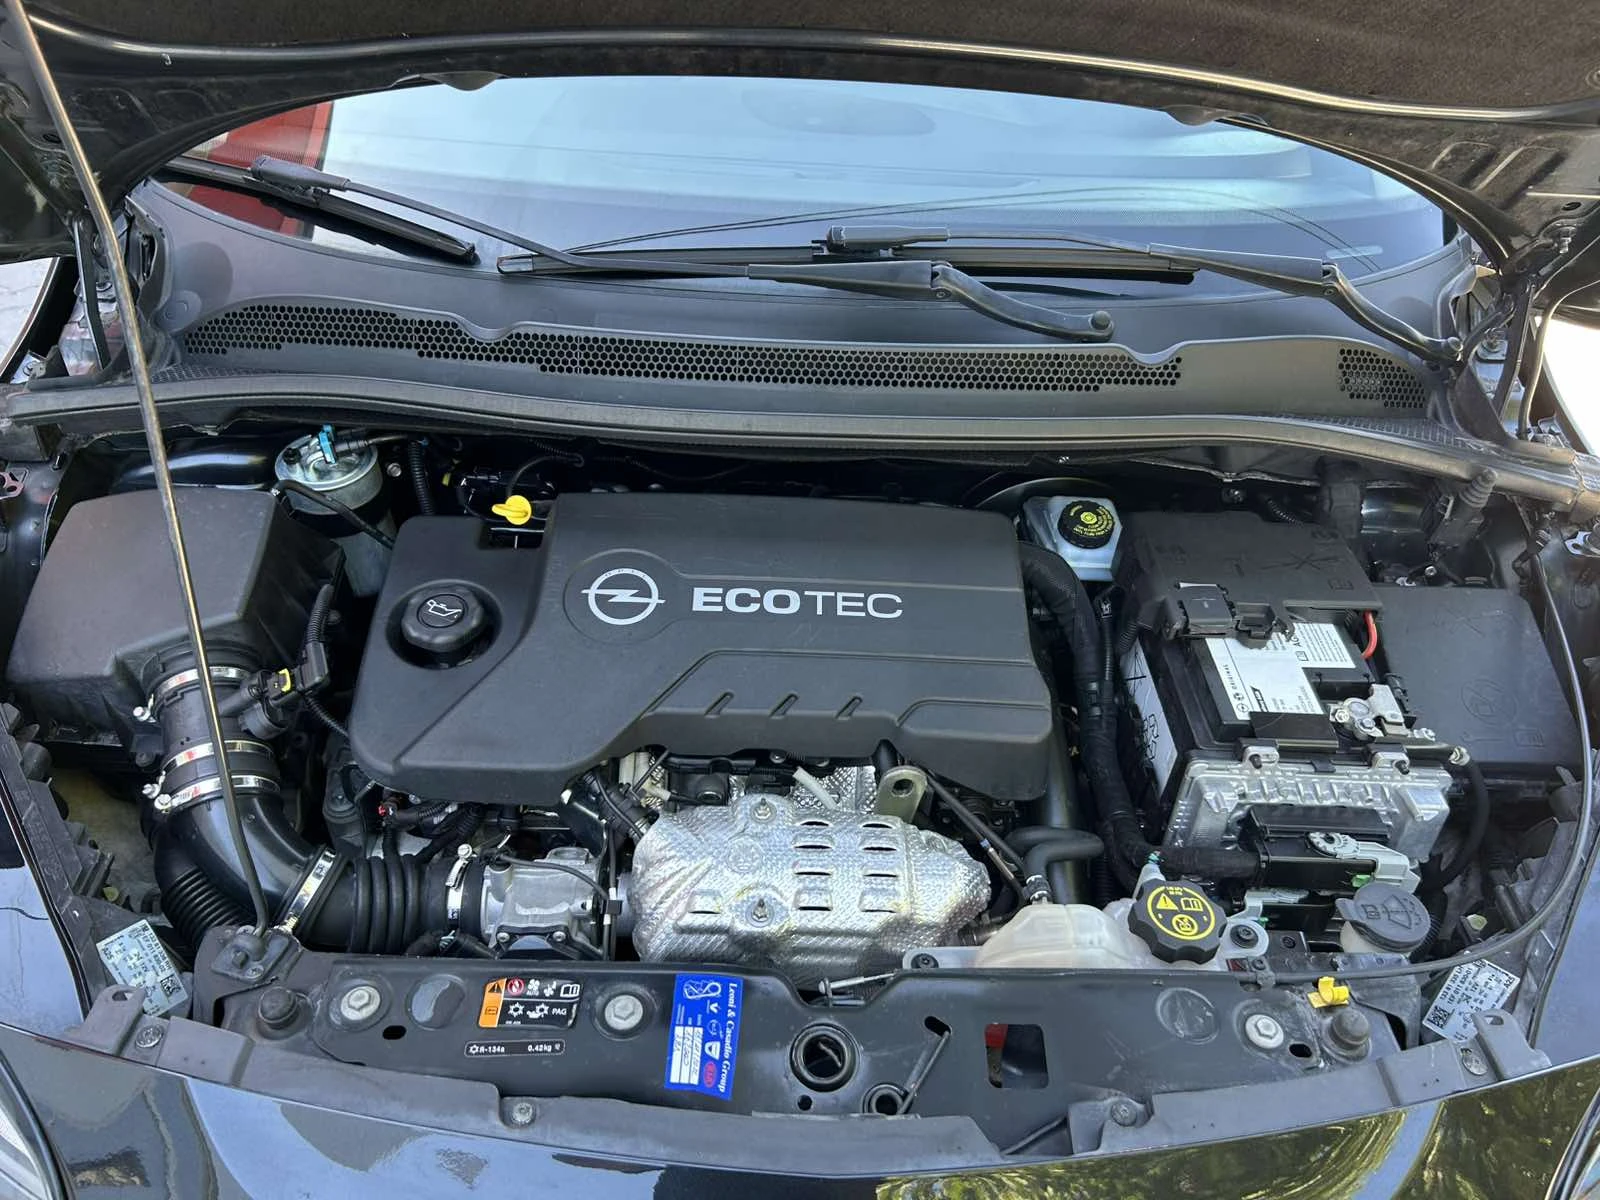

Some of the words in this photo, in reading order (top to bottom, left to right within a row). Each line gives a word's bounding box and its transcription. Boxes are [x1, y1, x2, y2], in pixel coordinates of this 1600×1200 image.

[692, 586, 903, 619] ECOTEC
[1504, 977, 1514, 988] A25
[728, 983, 738, 1008] Leoni
[727, 1009, 736, 1018] &
[479, 1045, 505, 1053] R-134a
[724, 1020, 735, 1059] Casadio
[718, 1061, 730, 1093] Group
